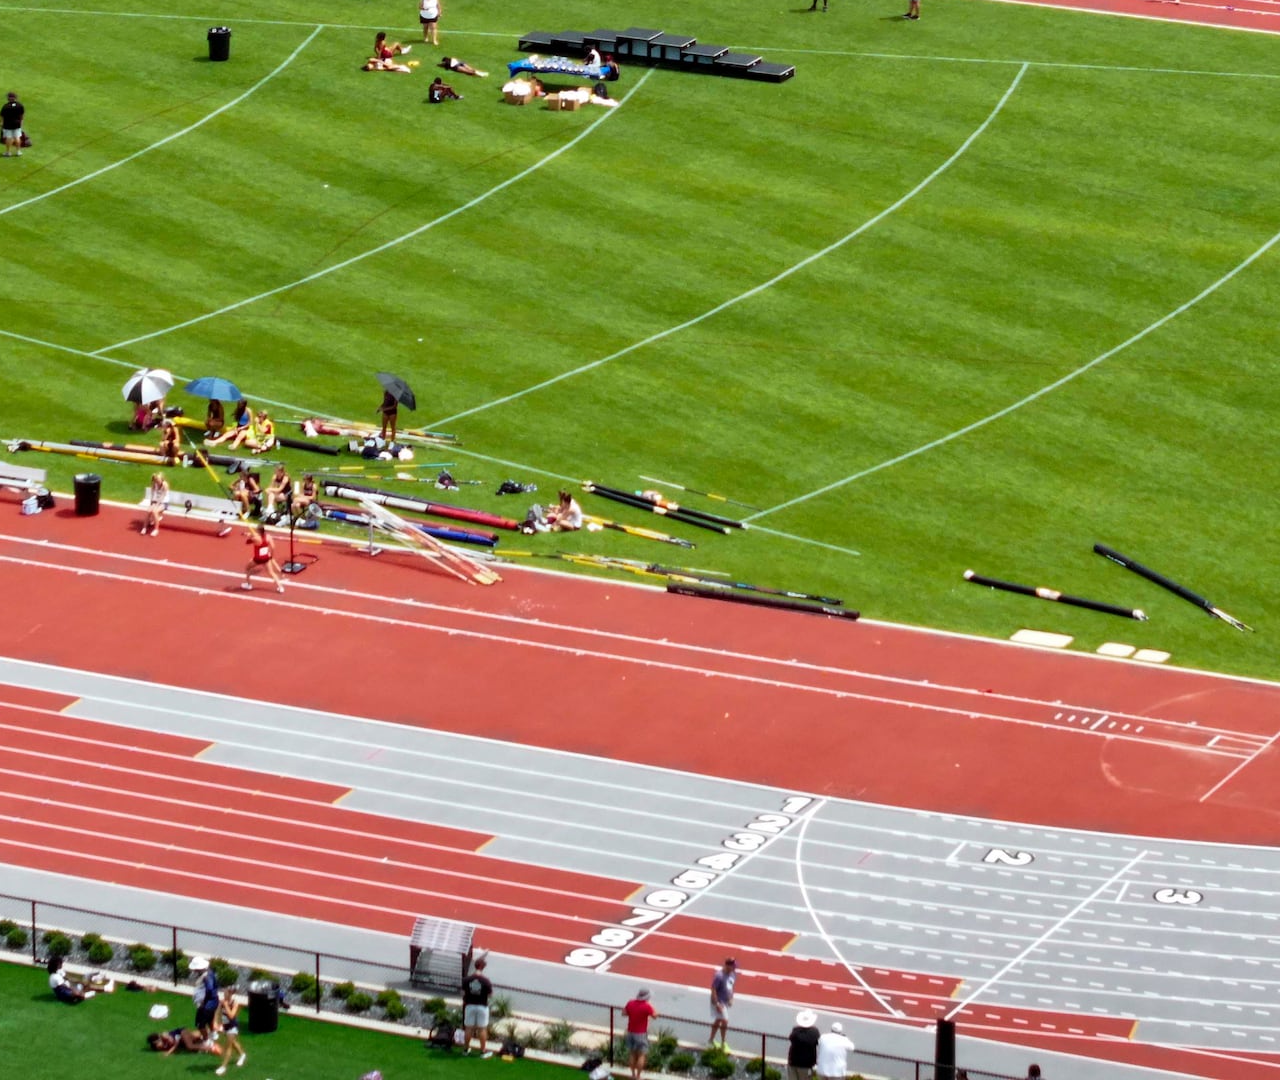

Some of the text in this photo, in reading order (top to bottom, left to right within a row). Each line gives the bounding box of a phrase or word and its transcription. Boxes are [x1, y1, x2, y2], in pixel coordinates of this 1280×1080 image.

[781, 796, 813, 813] 1
[745, 814, 793, 833] 2
[722, 832, 767, 851] 3
[697, 852, 742, 870] 4
[983, 848, 1035, 866] 2
[671, 870, 718, 889] 5
[644, 890, 689, 907] 6
[1154, 888, 1203, 905] 3
[621, 908, 666, 927] 7
[591, 929, 637, 947] 8
[564, 948, 608, 967] 9
